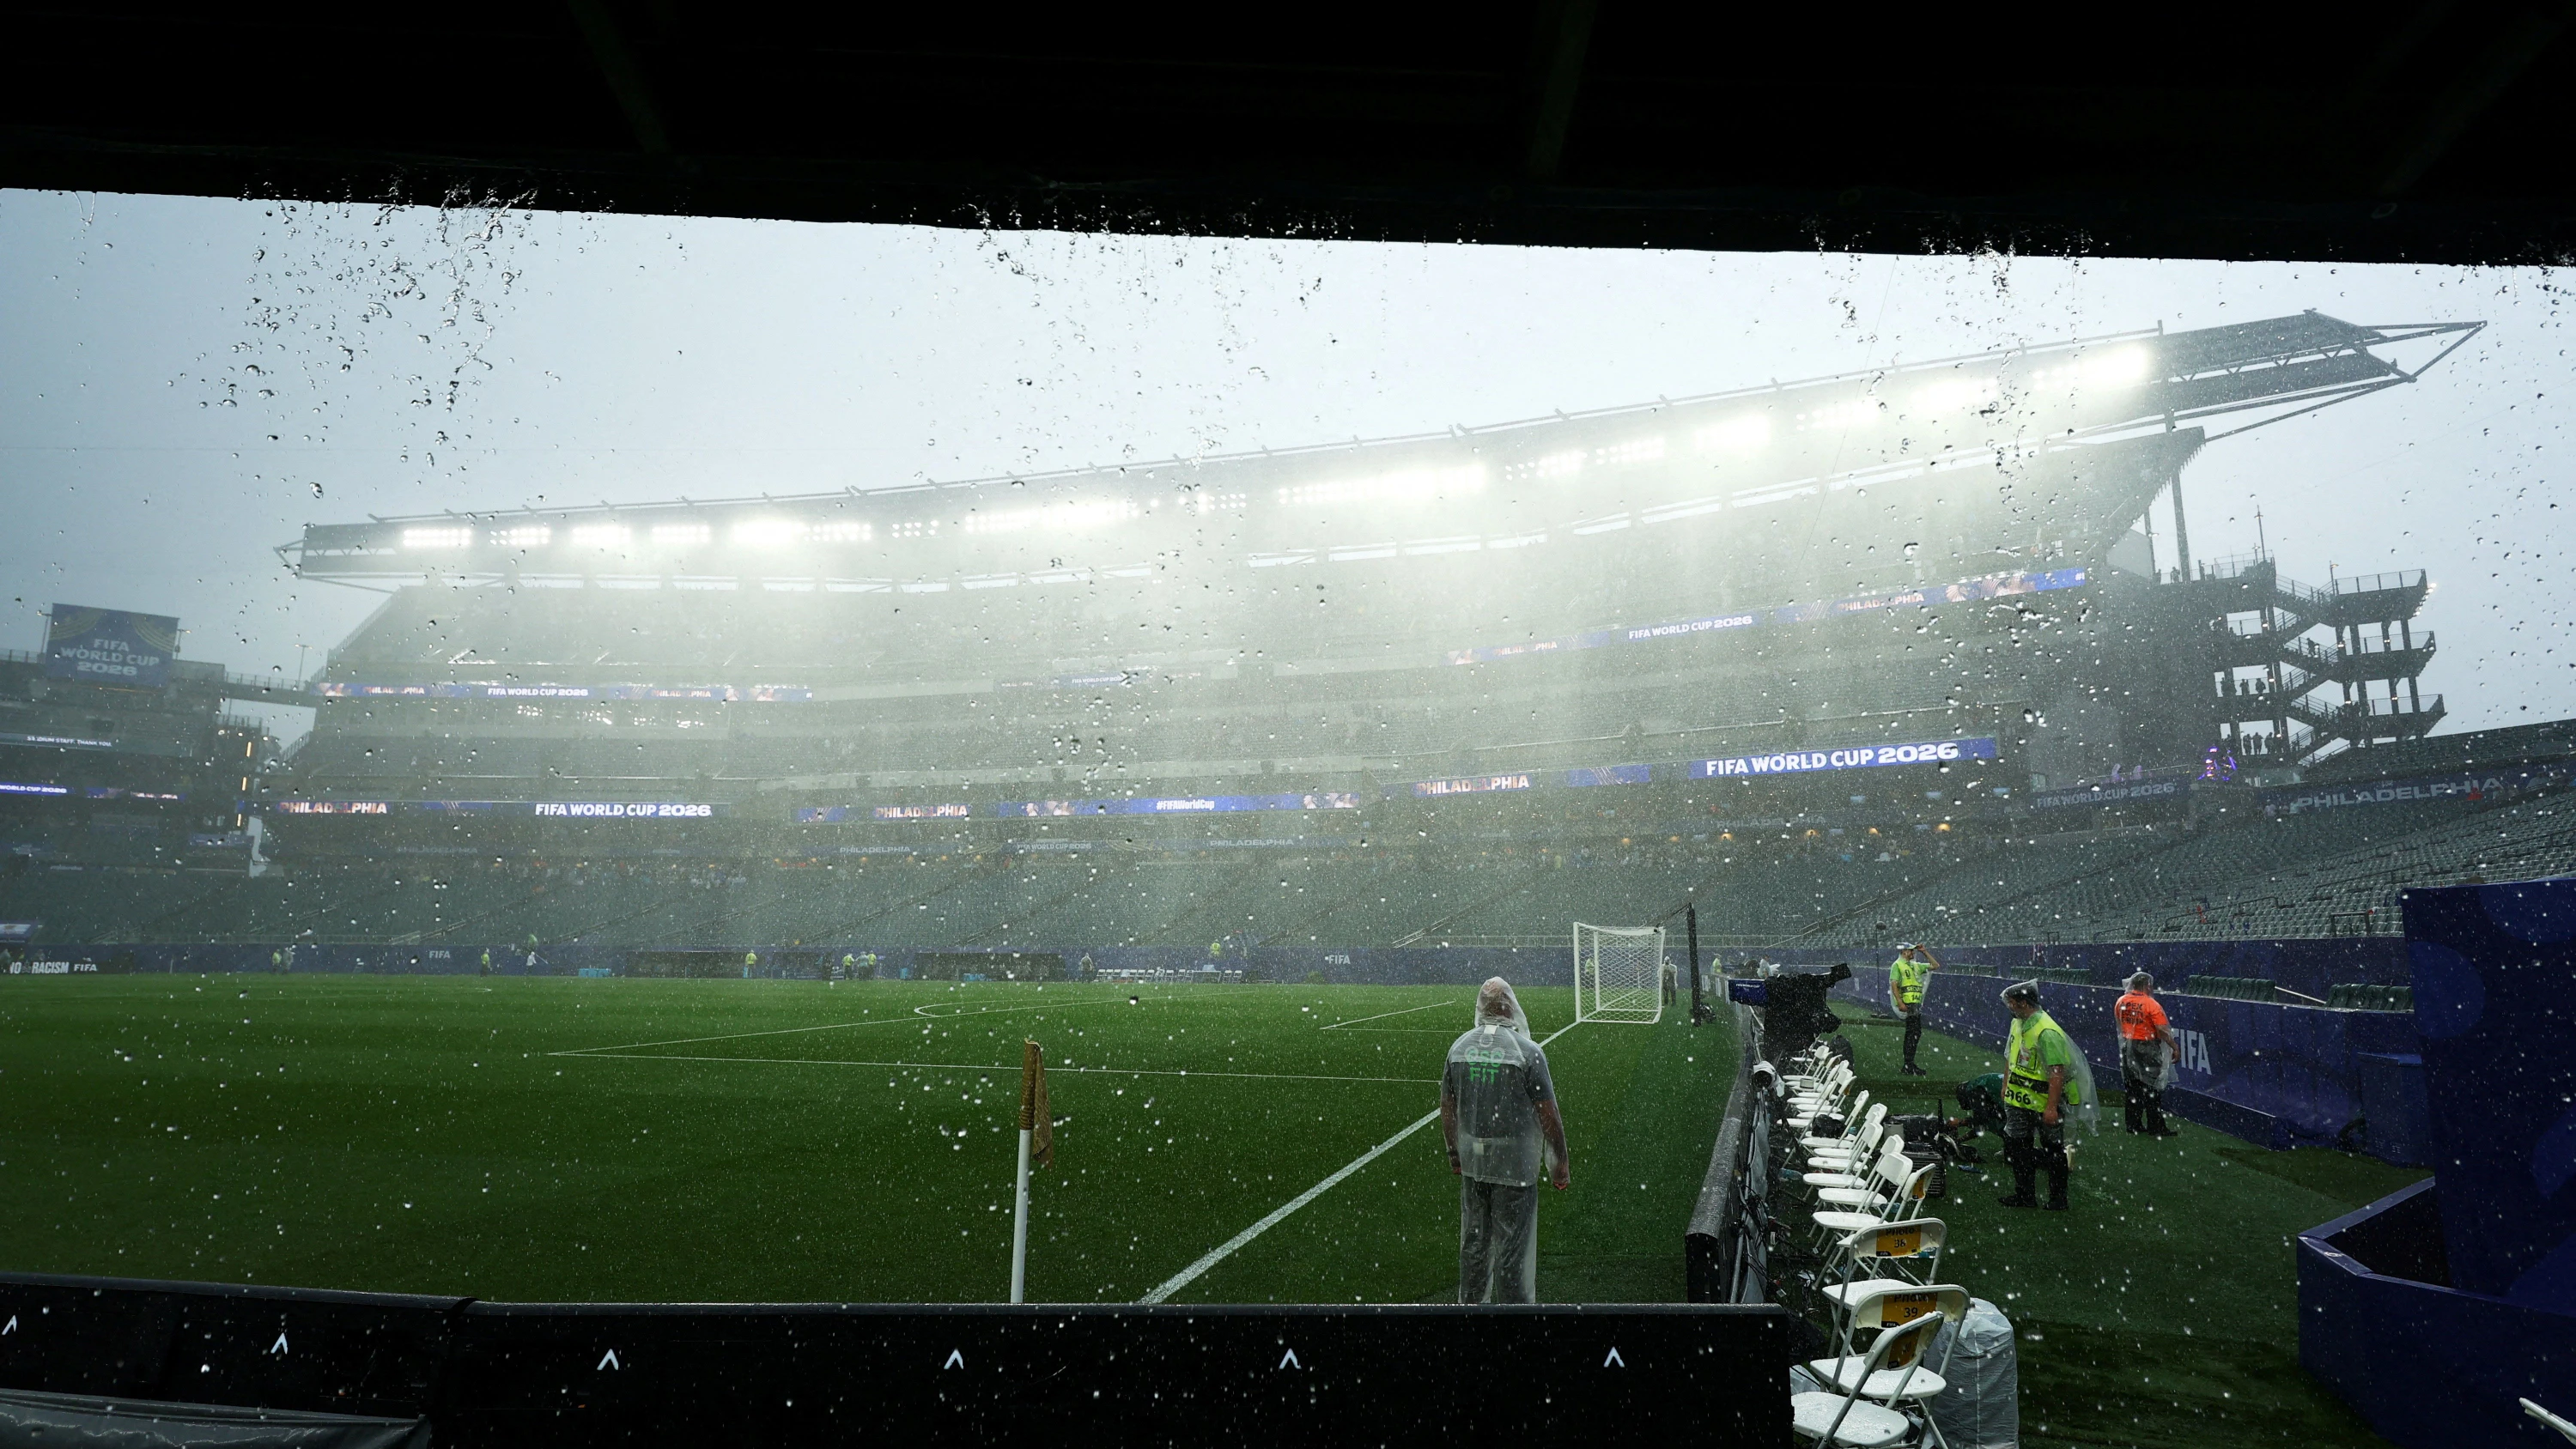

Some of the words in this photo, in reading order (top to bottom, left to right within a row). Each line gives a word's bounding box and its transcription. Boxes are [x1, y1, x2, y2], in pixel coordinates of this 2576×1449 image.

[1628, 627, 1651, 640] FIFA
[1651, 623, 1690, 637] WORLD
[1691, 621, 1713, 632] CUP
[1713, 615, 1753, 628] 2026
[93, 638, 131, 652] FIFA
[60, 646, 124, 664] WORLD
[125, 653, 161, 667] CUP
[76, 661, 138, 676] 2026
[488, 688, 507, 696] FIFA
[507, 688, 539, 696] WORLD
[539, 688, 558, 696] CUP
[557, 688, 589, 697] 2026
[1706, 758, 1749, 776] FIFA
[1752, 752, 1827, 773] WORLD
[1830, 749, 1874, 767] CUP
[1877, 742, 1959, 764] 2026
[2037, 797, 2061, 809] FIFA
[2062, 791, 2103, 806] WORLD
[2104, 788, 2129, 801] CUP
[2130, 782, 2176, 797] 2026
[535, 803, 568, 815] FIFA
[569, 803, 625, 816] WORLD
[626, 803, 657, 816] CUP
[658, 804, 712, 817] 2026
[1156, 798, 1215, 811] #FIFAWorldCup
[429, 950, 451, 959] FIFA
[1328, 955, 1351, 964] FIFA
[31, 961, 70, 974] RACISM
[73, 963, 97, 972] FIFA
[1469, 1067, 1499, 1085] FIT
[1894, 1239, 1906, 1248] 38
[1903, 1307, 1918, 1318] 39
